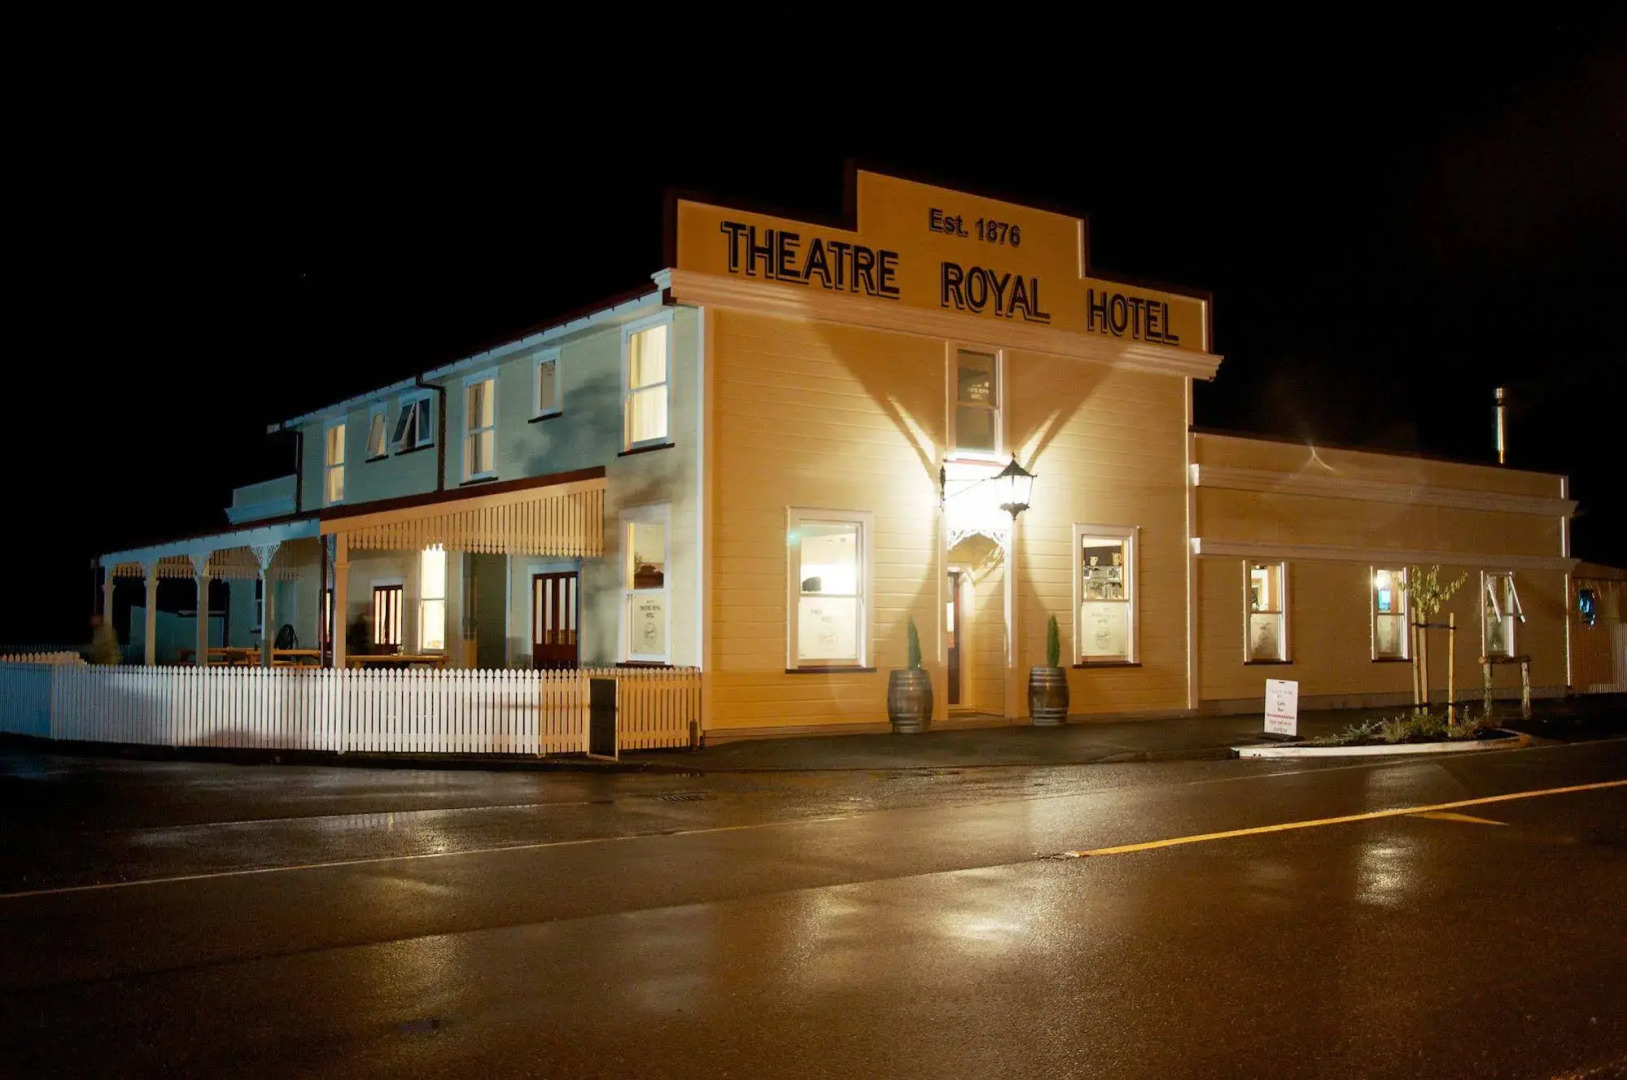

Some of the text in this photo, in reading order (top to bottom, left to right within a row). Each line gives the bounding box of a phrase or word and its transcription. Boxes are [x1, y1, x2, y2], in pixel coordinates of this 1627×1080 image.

[929, 208, 1021, 247] Est. 1876
[721, 221, 1180, 346] THEATRE ROYAL HOTEL
